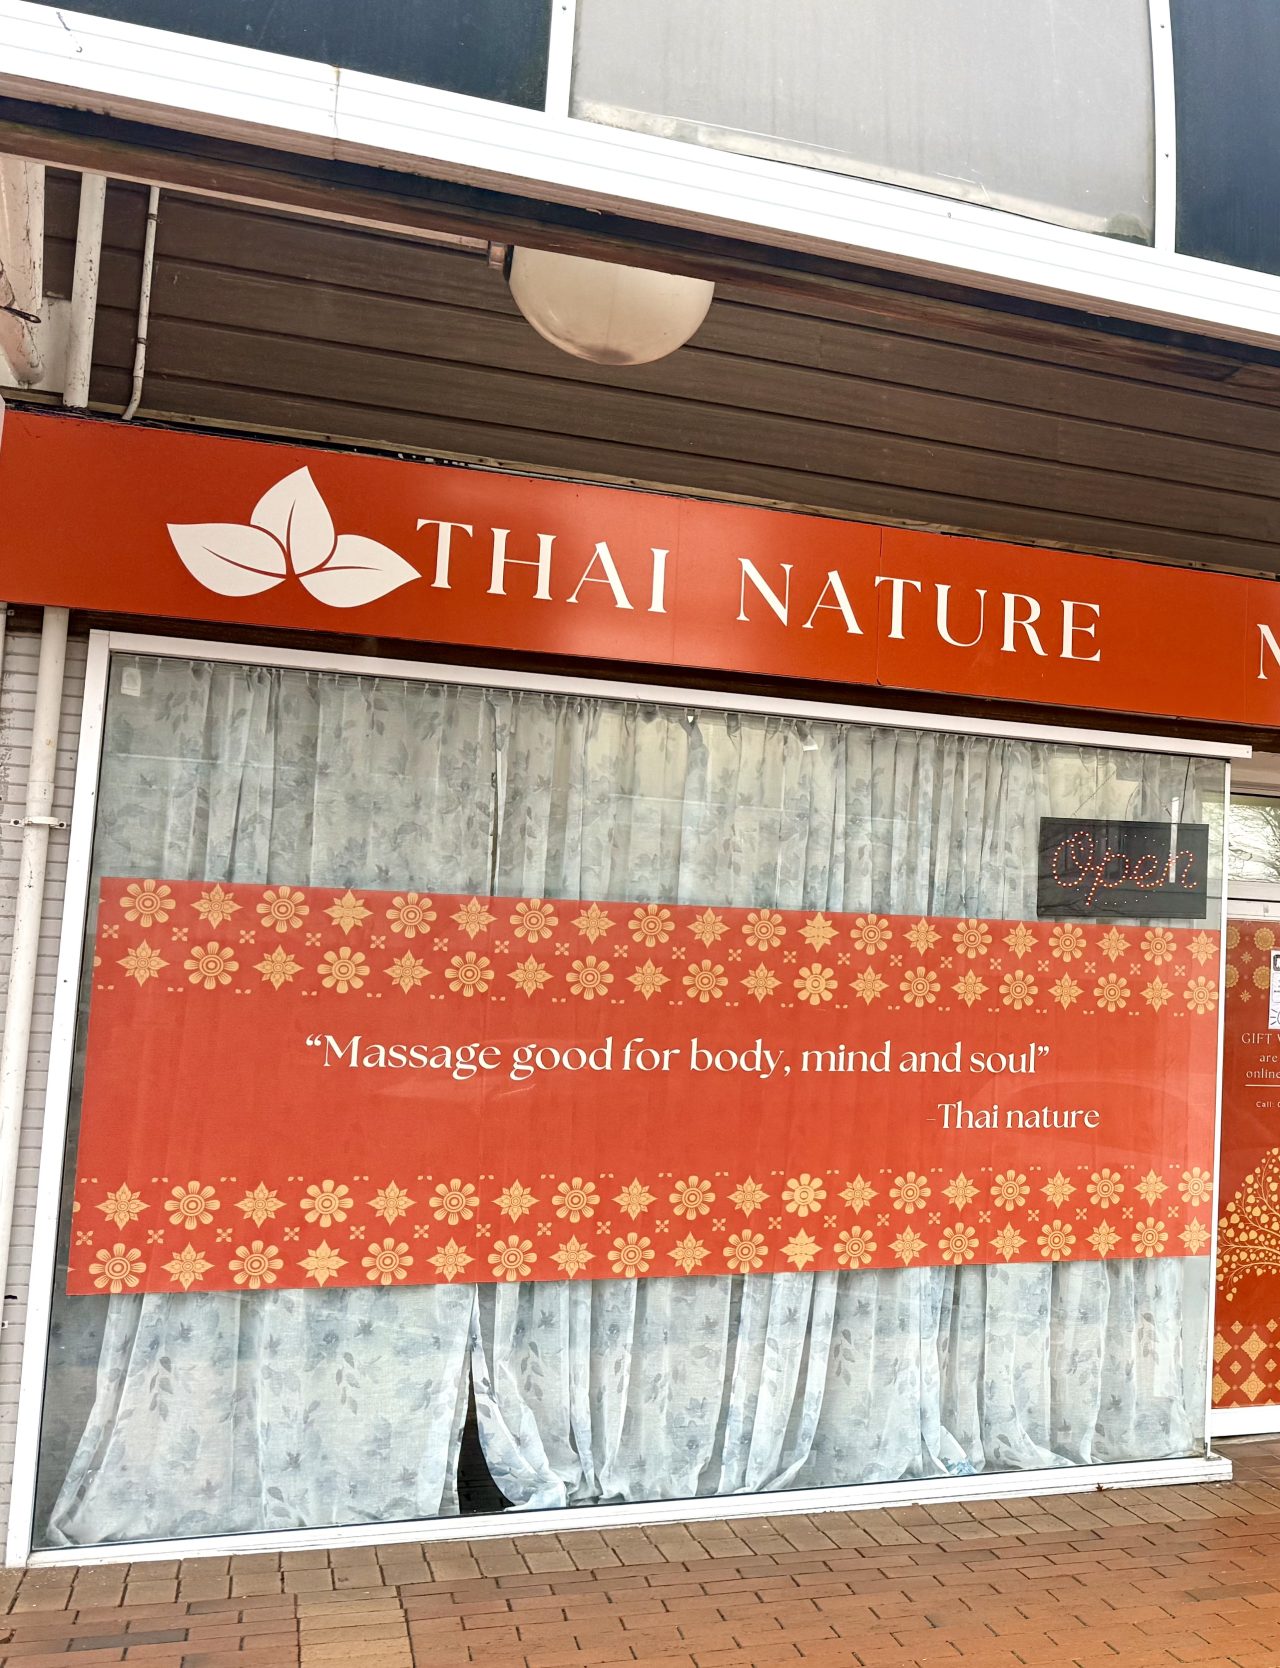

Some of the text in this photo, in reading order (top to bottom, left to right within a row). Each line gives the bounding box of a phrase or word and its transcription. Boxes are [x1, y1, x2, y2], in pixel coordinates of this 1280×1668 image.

[416, 518, 670, 614] THAI
[736, 557, 1100, 661] NATURE
[1053, 831, 1196, 906] Open
[1241, 1032, 1272, 1044] GIFT
[306, 1033, 1050, 1081] “Massage good for body, mind and soul”
[1259, 1055, 1278, 1063] are
[1006, 1105, 1100, 1129] nature
